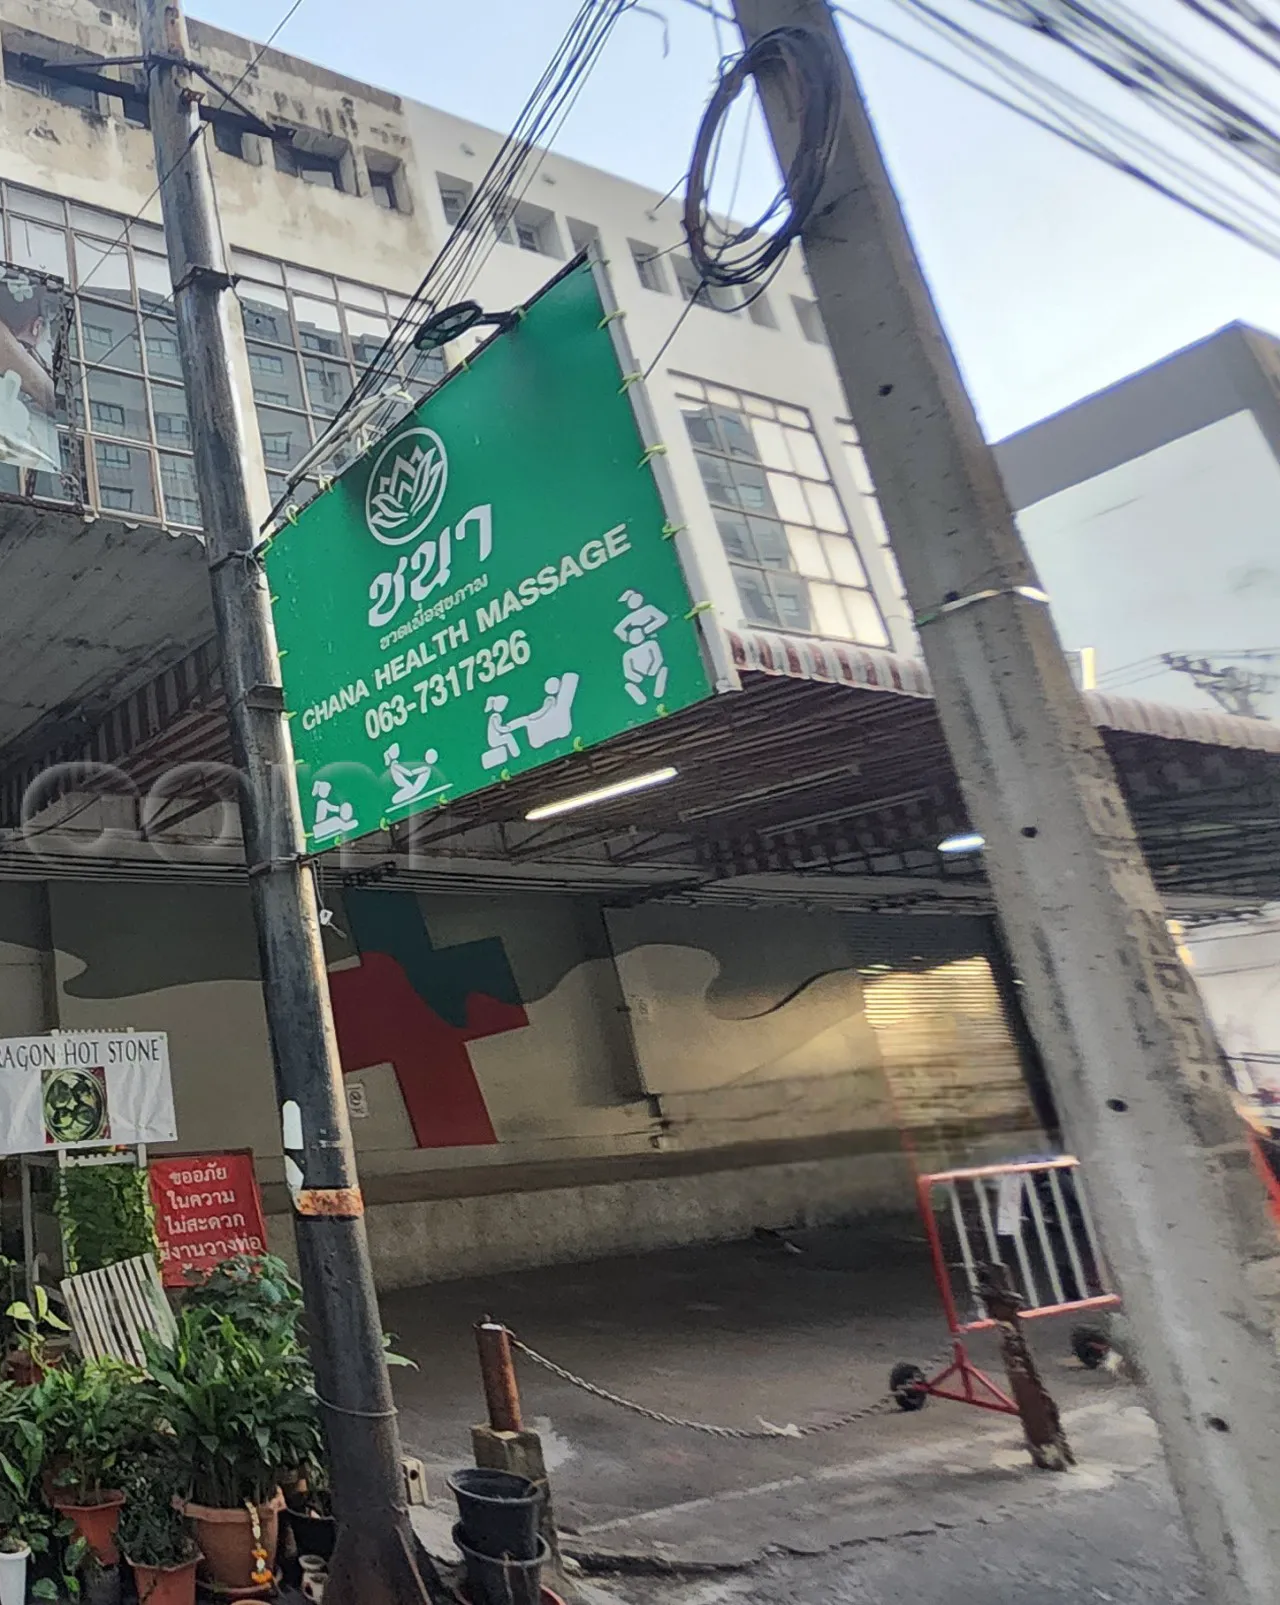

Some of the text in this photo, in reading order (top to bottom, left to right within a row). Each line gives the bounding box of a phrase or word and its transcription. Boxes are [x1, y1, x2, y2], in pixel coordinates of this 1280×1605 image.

[368, 503, 493, 628] ชนา
[302, 523, 632, 731] CHANA HEALTH MASSAGE
[365, 630, 531, 740] 063-7317326
[64, 1040, 99, 1065] HOT
[108, 1038, 161, 1064] STONE
[169, 1162, 228, 1186] ขออภัย
[166, 1189, 236, 1210] ในความ
[164, 1213, 246, 1235] ไม่สะดวก
